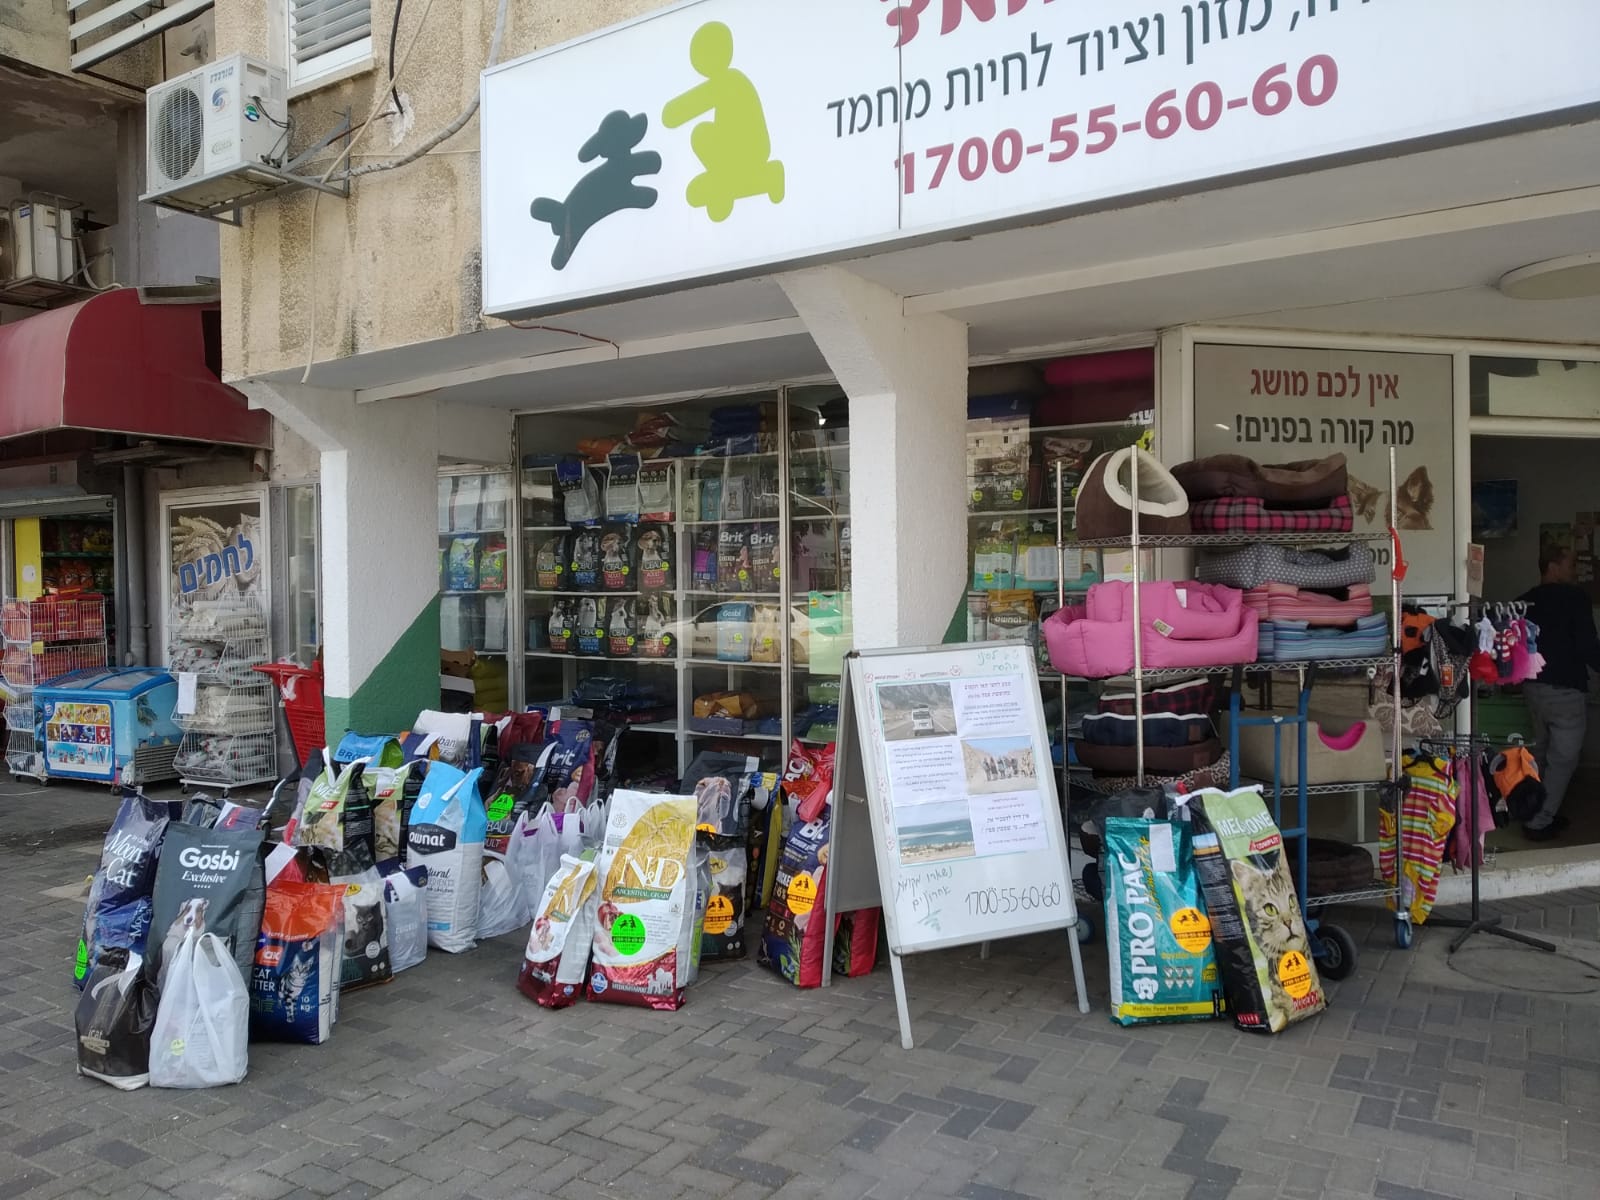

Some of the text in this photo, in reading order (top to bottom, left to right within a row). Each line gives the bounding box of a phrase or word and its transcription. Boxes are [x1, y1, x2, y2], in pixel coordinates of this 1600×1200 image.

[1067, 13, 1165, 76] וציוד
[944, 31, 1053, 111] לחיות
[827, 78, 931, 138] מחמד
[894, 54, 1338, 195] 1700-55-60-60
[1250, 365, 1399, 407] אין לכם מושג
[1236, 414, 1414, 453] מה קורה בפנים!
[719, 531, 744, 543] Brit
[750, 533, 773, 545] Brit
[178, 533, 254, 594] לחמים
[551, 750, 575, 766] rit
[408, 831, 446, 847] ownat
[486, 821, 508, 834] BAU
[103, 830, 143, 864] Moon
[179, 847, 241, 871] Gosbi
[106, 857, 137, 888] Cat
[181, 870, 228, 884] Exclusive
[427, 867, 451, 878] tural
[616, 854, 685, 890] N&D
[1118, 848, 1149, 905] PAC
[1129, 912, 1158, 975] PRO
[253, 967, 271, 979] CAT
[254, 979, 275, 992] TTER
